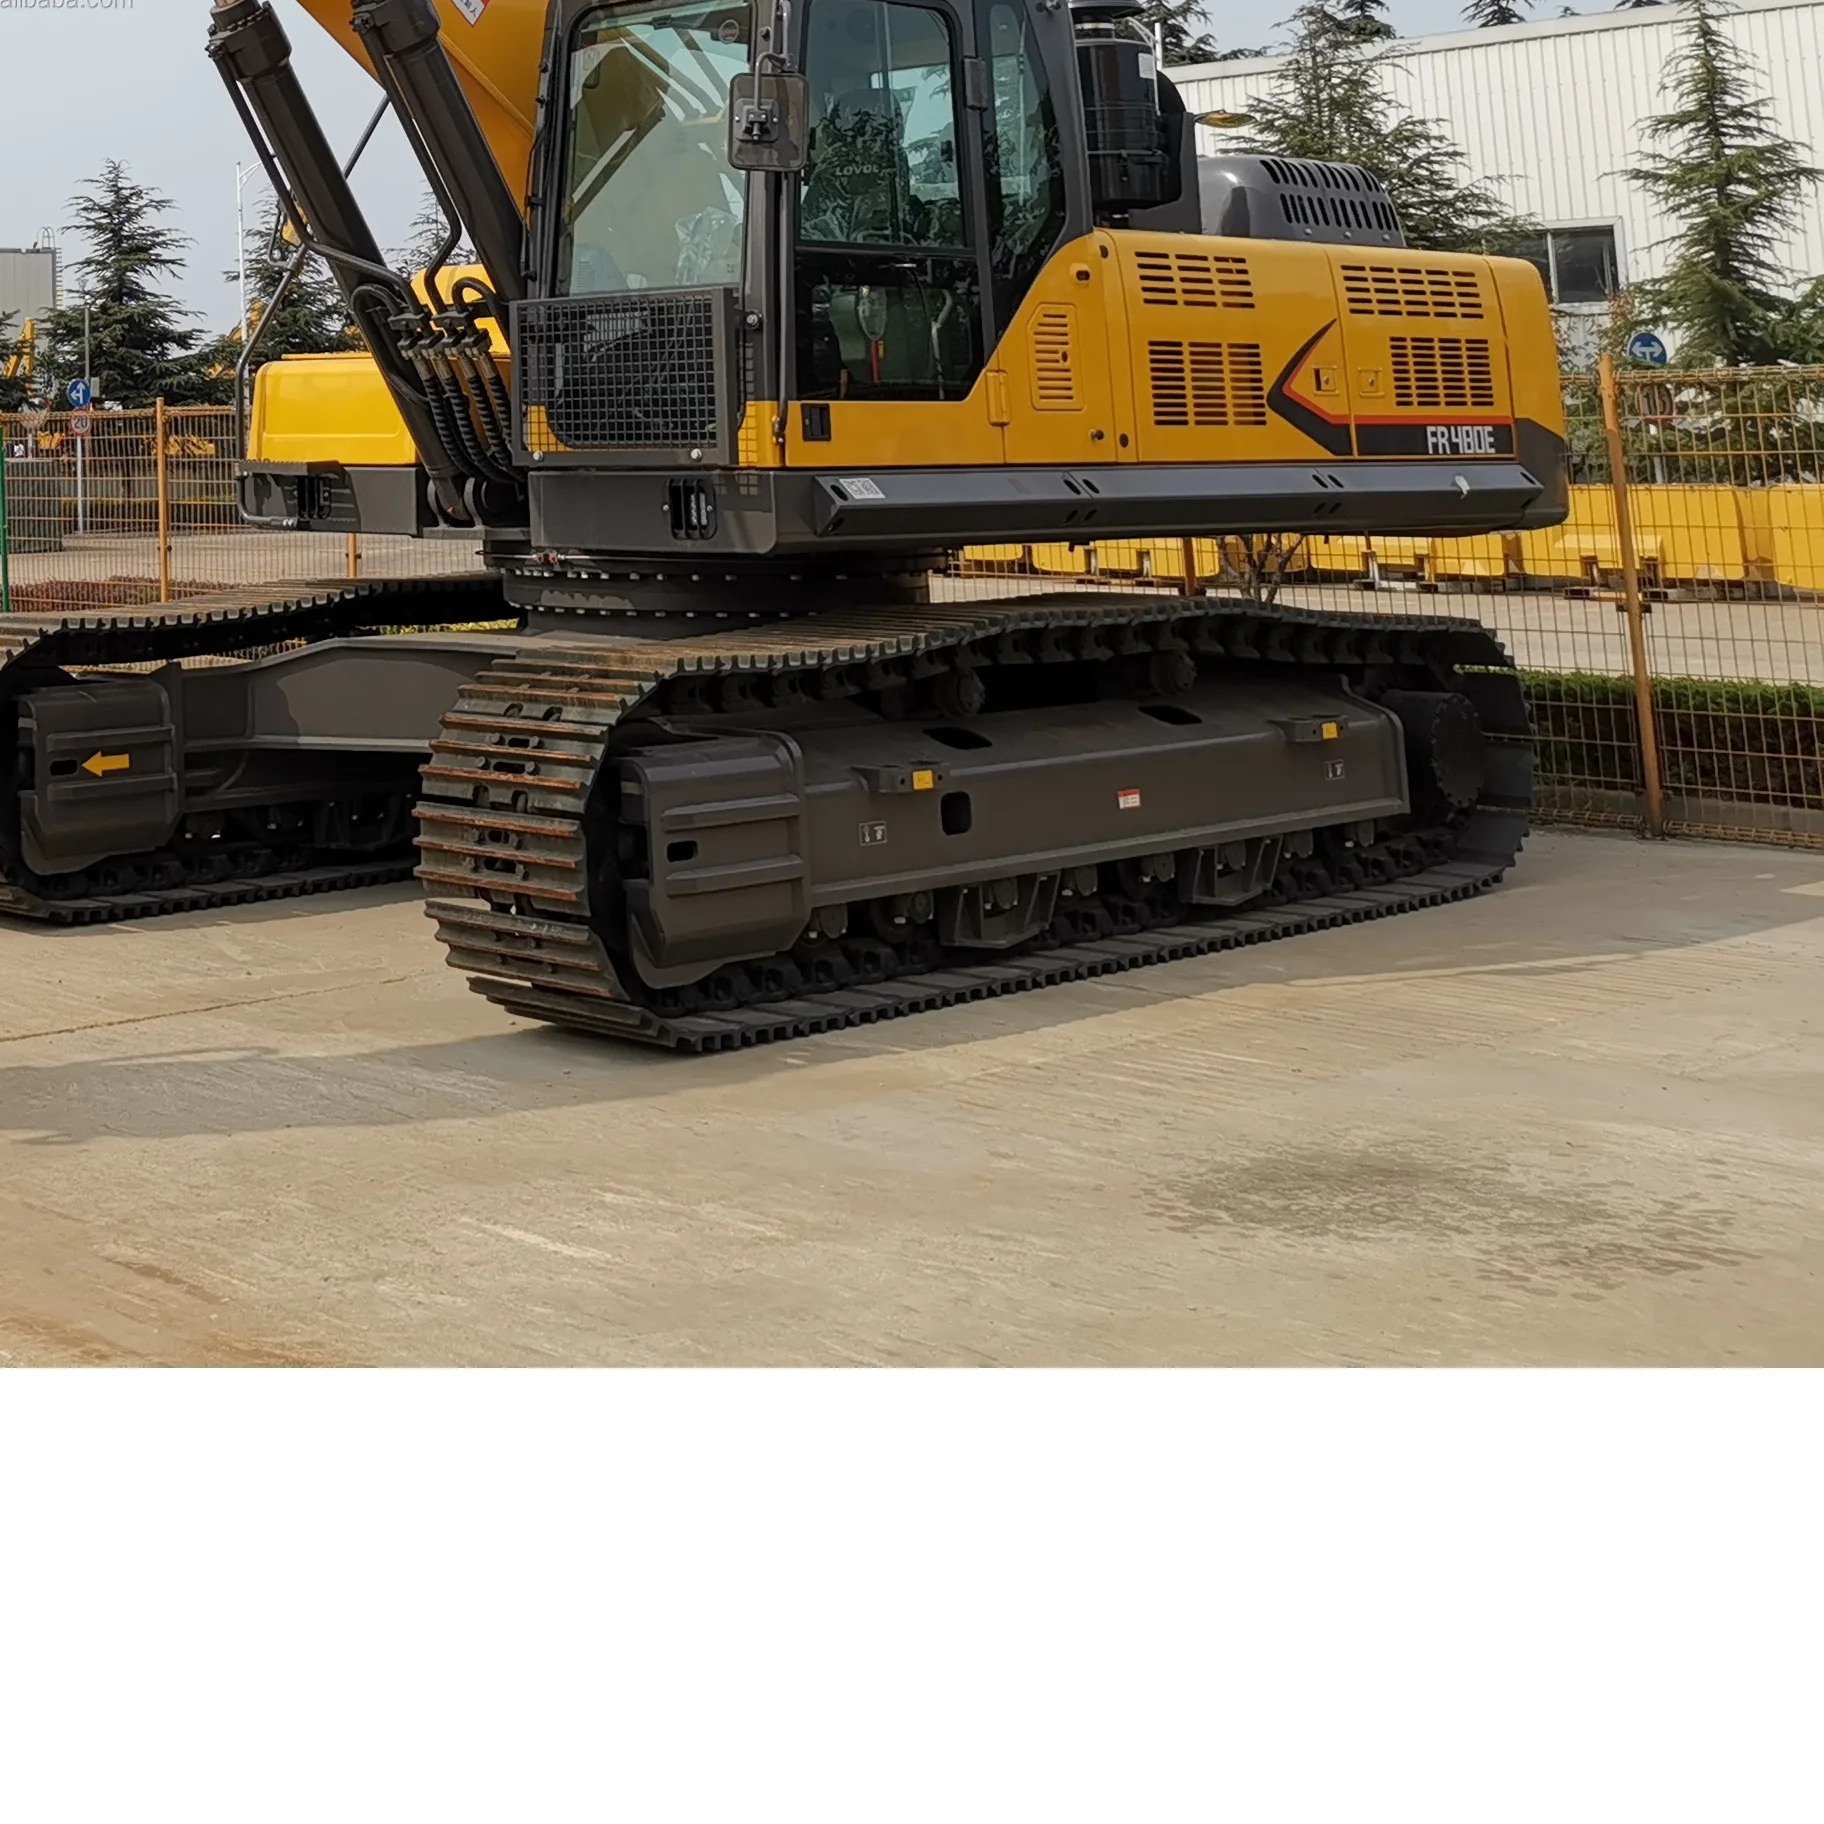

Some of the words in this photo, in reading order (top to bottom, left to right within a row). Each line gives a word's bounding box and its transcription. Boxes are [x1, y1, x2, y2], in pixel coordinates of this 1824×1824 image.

[835, 162, 879, 176] LOVOL
[74, 417, 88, 429] 20
[1426, 425, 1496, 455] FR480E
